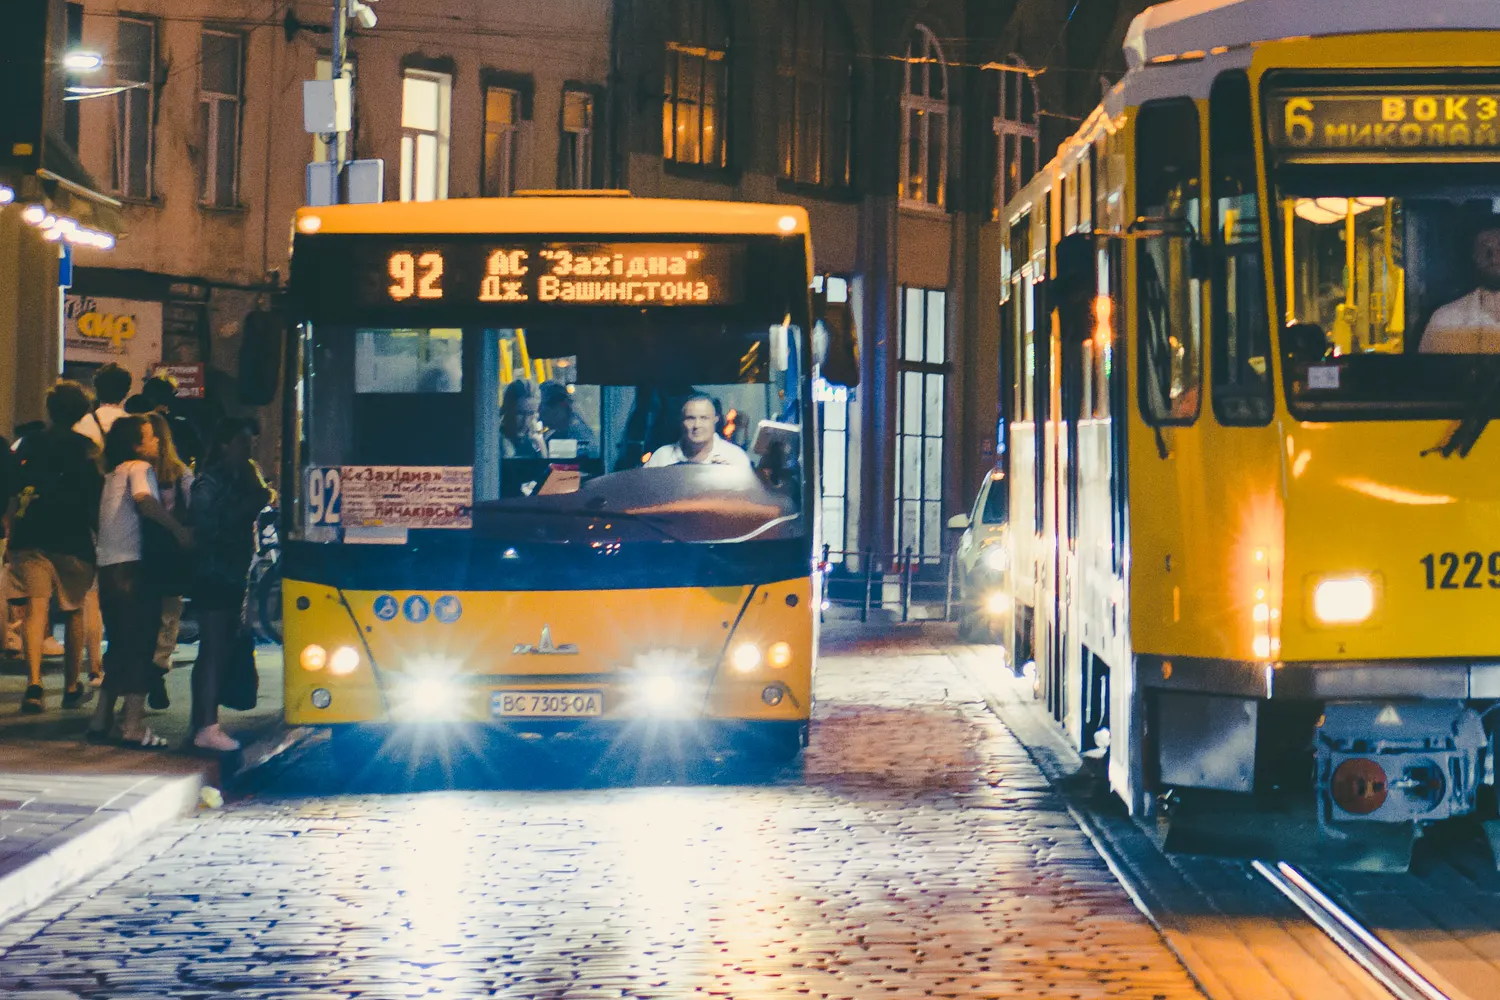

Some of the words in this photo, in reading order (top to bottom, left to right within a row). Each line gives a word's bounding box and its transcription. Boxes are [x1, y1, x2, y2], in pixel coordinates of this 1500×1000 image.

[1285, 97, 1314, 146] 6
[388, 251, 444, 301] 92
[486, 250, 528, 276] АС
[539, 250, 700, 278] "Західна"
[537, 275, 709, 302] Вашингтона
[310, 469, 340, 524] 92
[503, 696, 526, 712] BC
[531, 696, 569, 712] 7305
